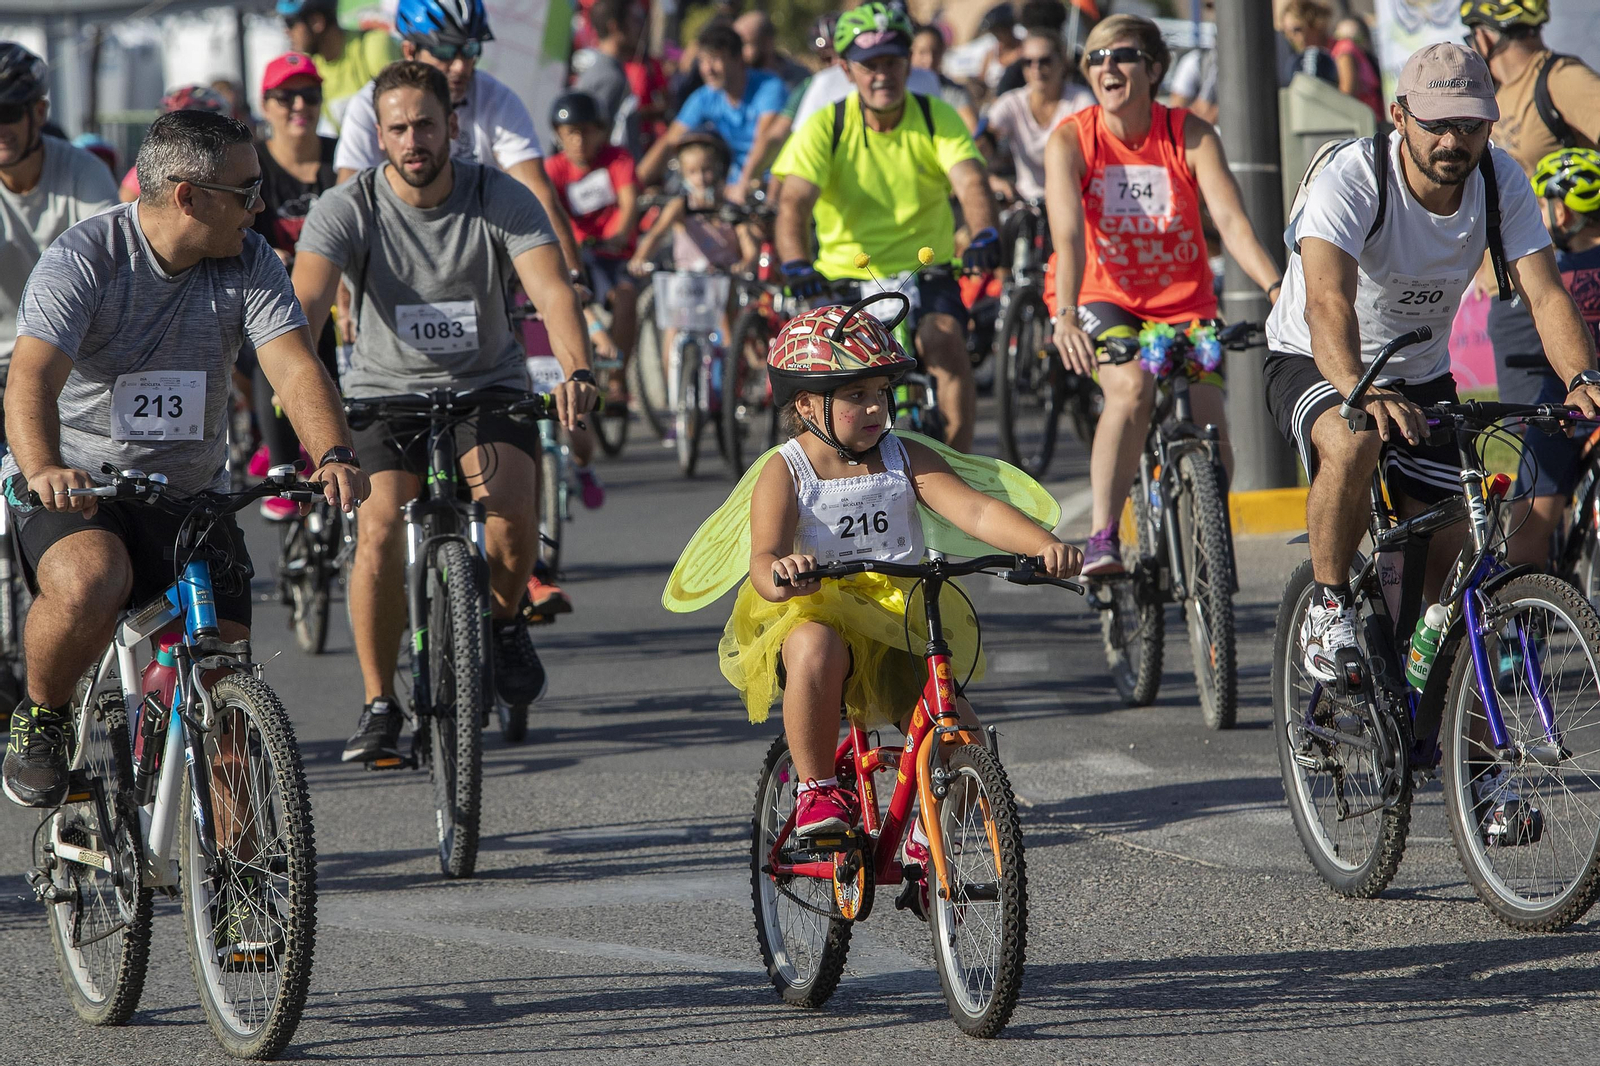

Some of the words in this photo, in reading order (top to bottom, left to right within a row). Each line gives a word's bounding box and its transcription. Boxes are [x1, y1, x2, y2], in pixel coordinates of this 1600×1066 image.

[1118, 183, 1153, 199] 754
[1398, 290, 1443, 305] 250
[411, 321, 464, 340] 1083
[133, 394, 183, 418] 213
[837, 510, 889, 539] 216
